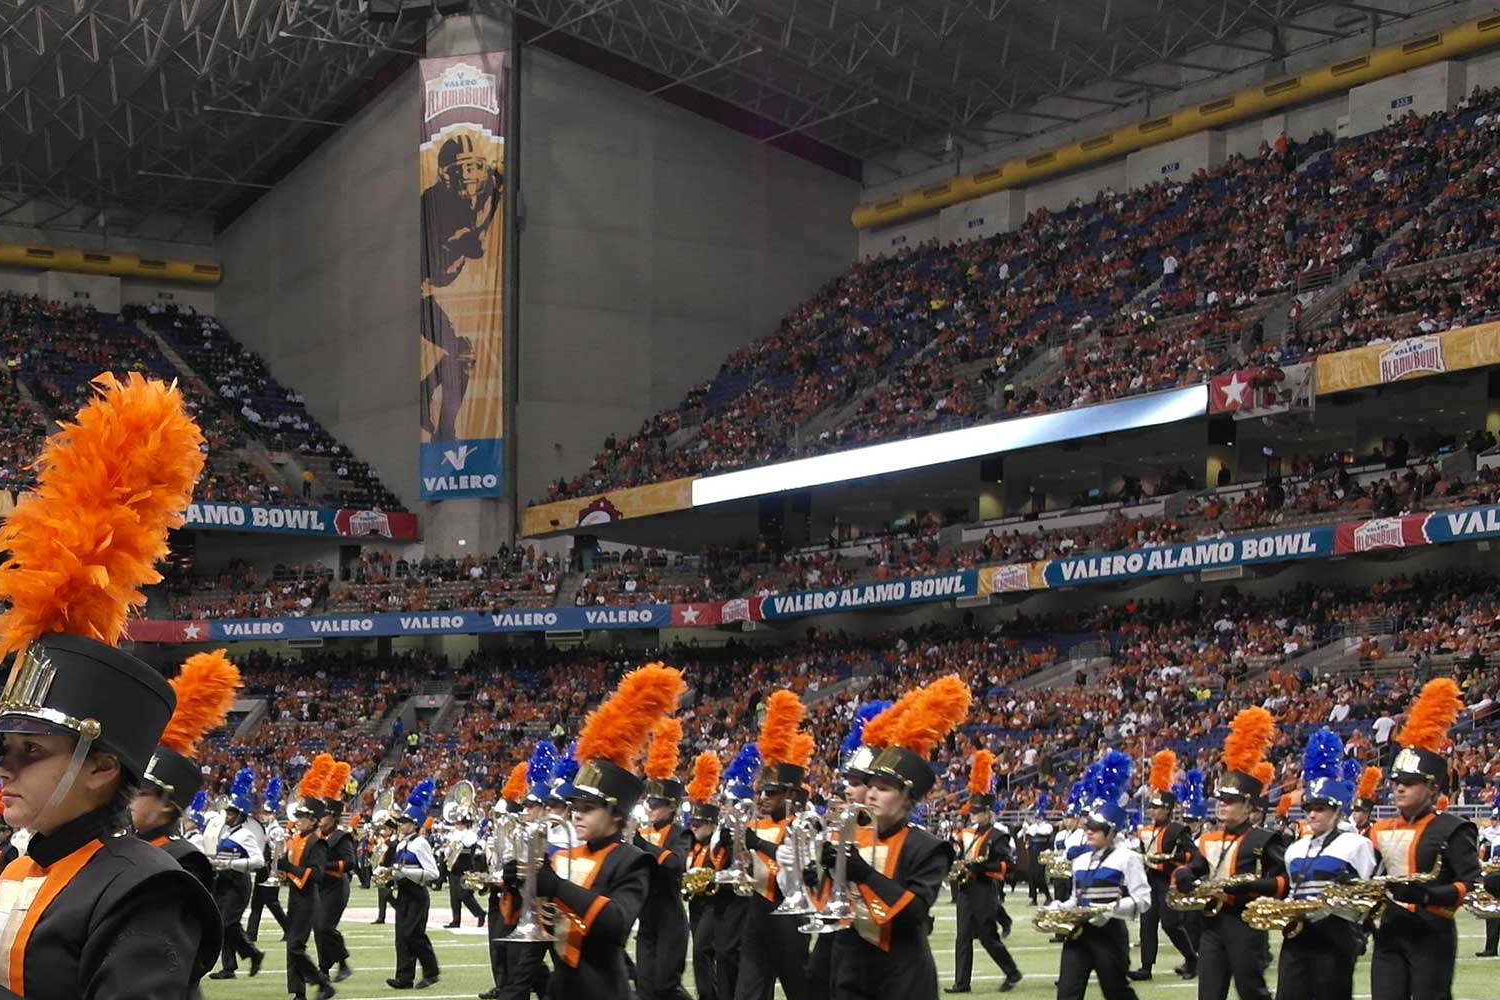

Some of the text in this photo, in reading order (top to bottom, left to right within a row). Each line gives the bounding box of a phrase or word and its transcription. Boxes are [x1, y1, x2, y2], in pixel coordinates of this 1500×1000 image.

[1395, 343, 1423, 356] VALERO
[423, 474, 498, 491] VALERO
[251, 507, 325, 532] BOWL
[1061, 553, 1143, 582] VALERO
[1147, 539, 1234, 571] ALAMO
[1241, 532, 1316, 561] BOWL
[773, 590, 837, 615] VALERO
[839, 582, 905, 606] ALAMO
[909, 575, 965, 600] BOWL
[400, 617, 464, 631] VALERO
[492, 613, 557, 630] VALERO
[585, 609, 652, 625] VALERO
[222, 622, 284, 637] VALERO
[310, 619, 373, 634] VALERO
